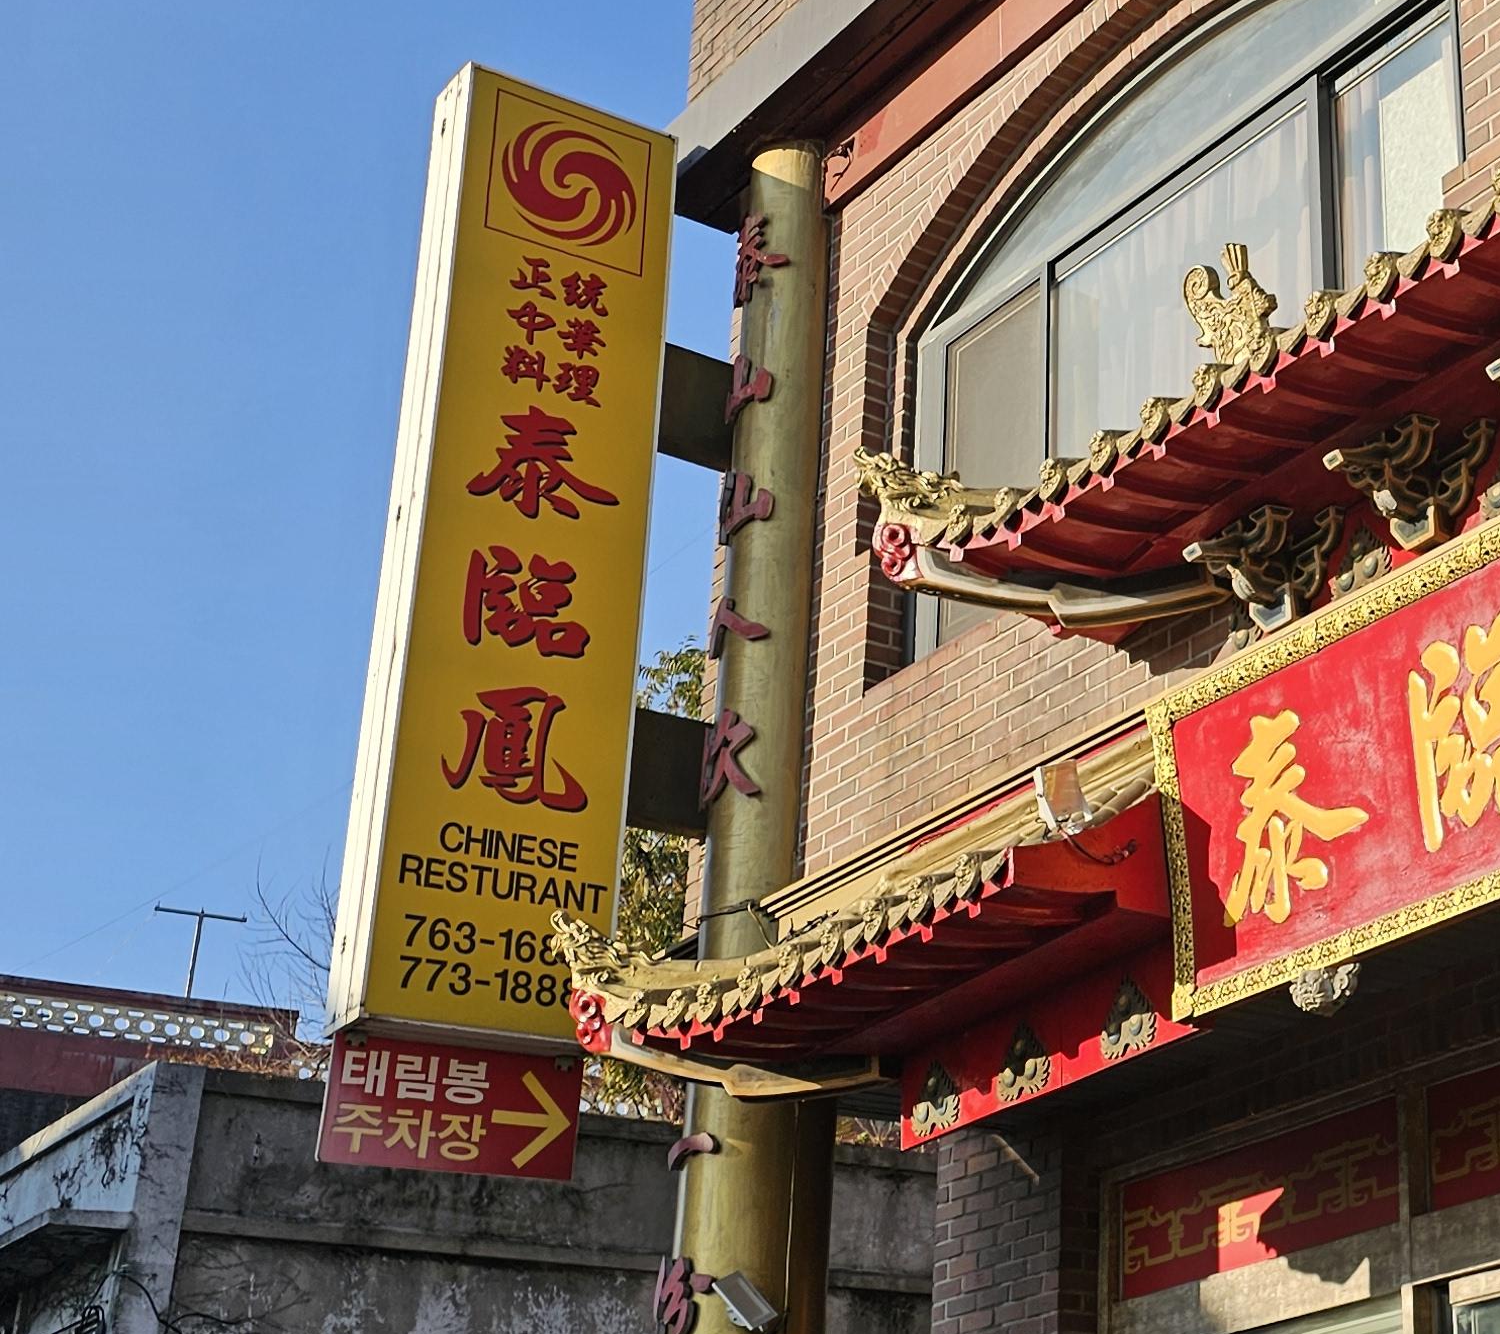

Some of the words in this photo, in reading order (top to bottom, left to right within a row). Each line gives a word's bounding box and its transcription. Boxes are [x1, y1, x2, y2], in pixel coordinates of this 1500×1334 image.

[439, 821, 579, 872] CHINESE
[398, 853, 608, 915] RESTURANT
[340, 1049, 491, 1105] 태림봉
[331, 1101, 487, 1161] 주차장
